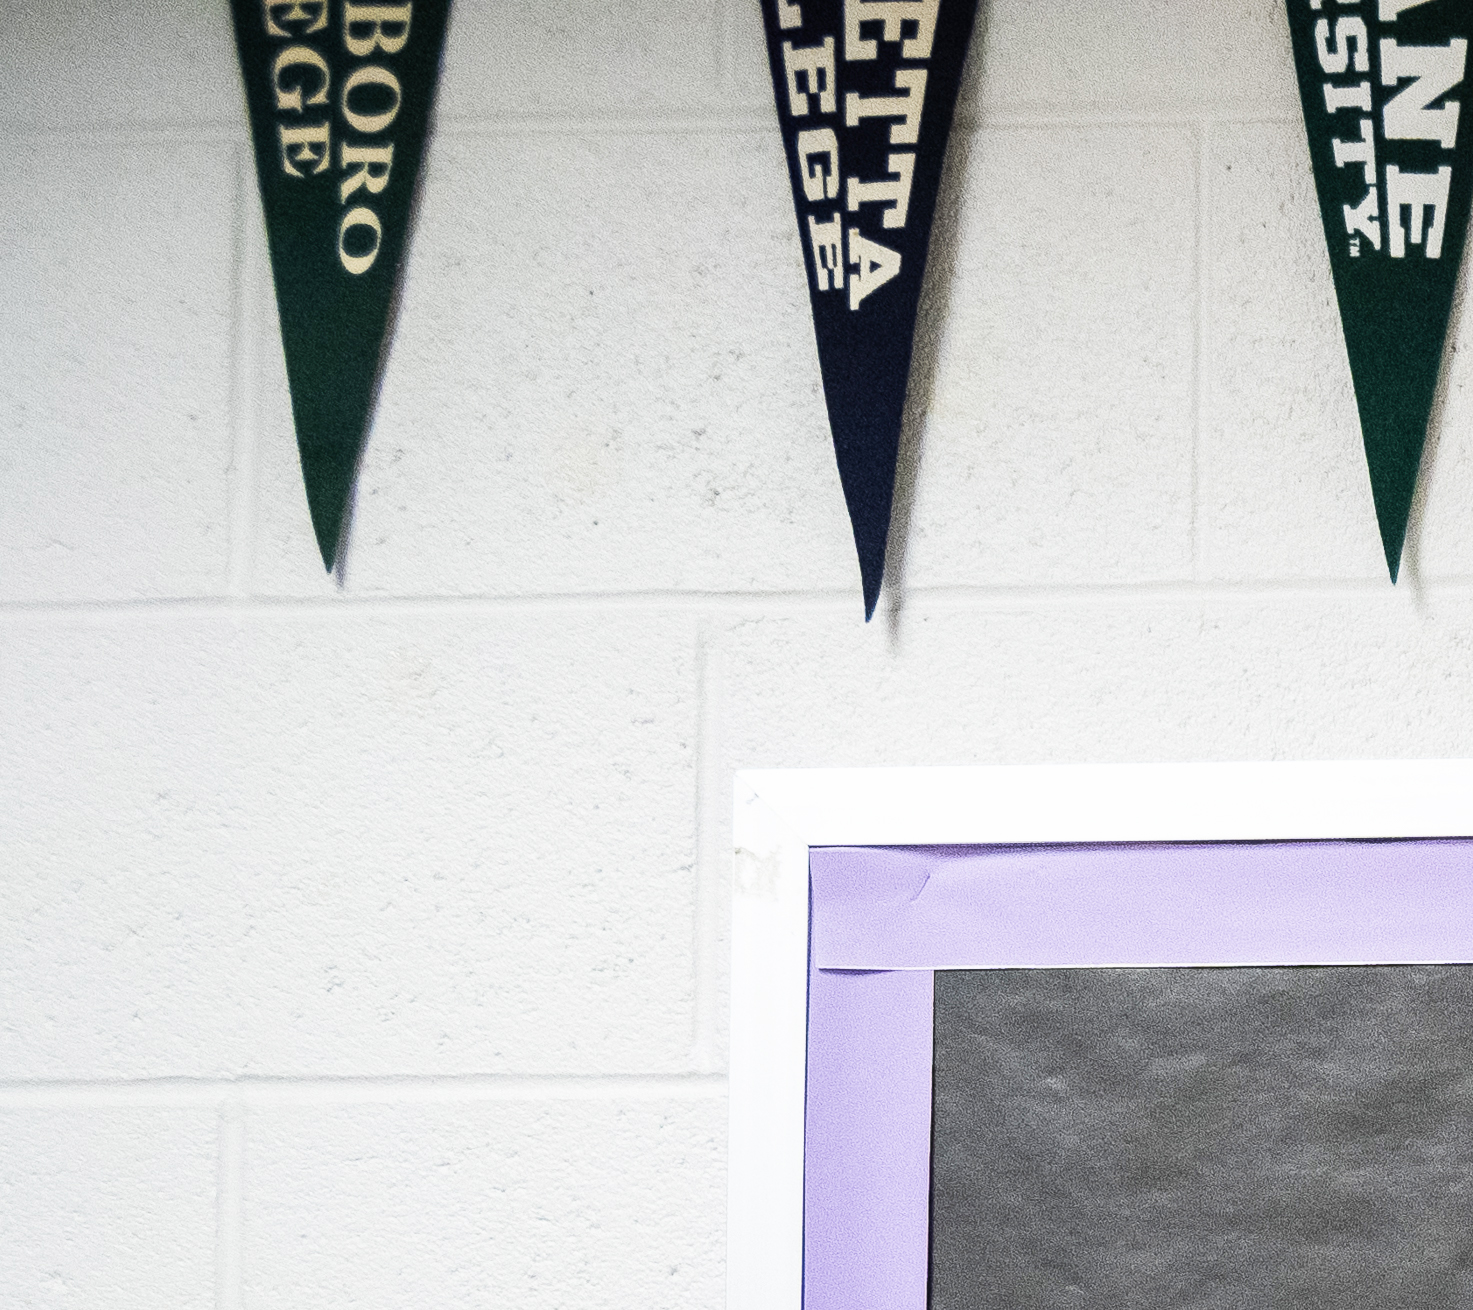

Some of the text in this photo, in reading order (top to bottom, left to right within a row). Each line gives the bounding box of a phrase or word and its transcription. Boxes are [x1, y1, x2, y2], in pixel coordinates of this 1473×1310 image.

[263, 0, 330, 179] EGE
[338, 2, 413, 275] BORO
[844, 0, 941, 311] ETTA
[1377, 0, 1469, 259] NE
